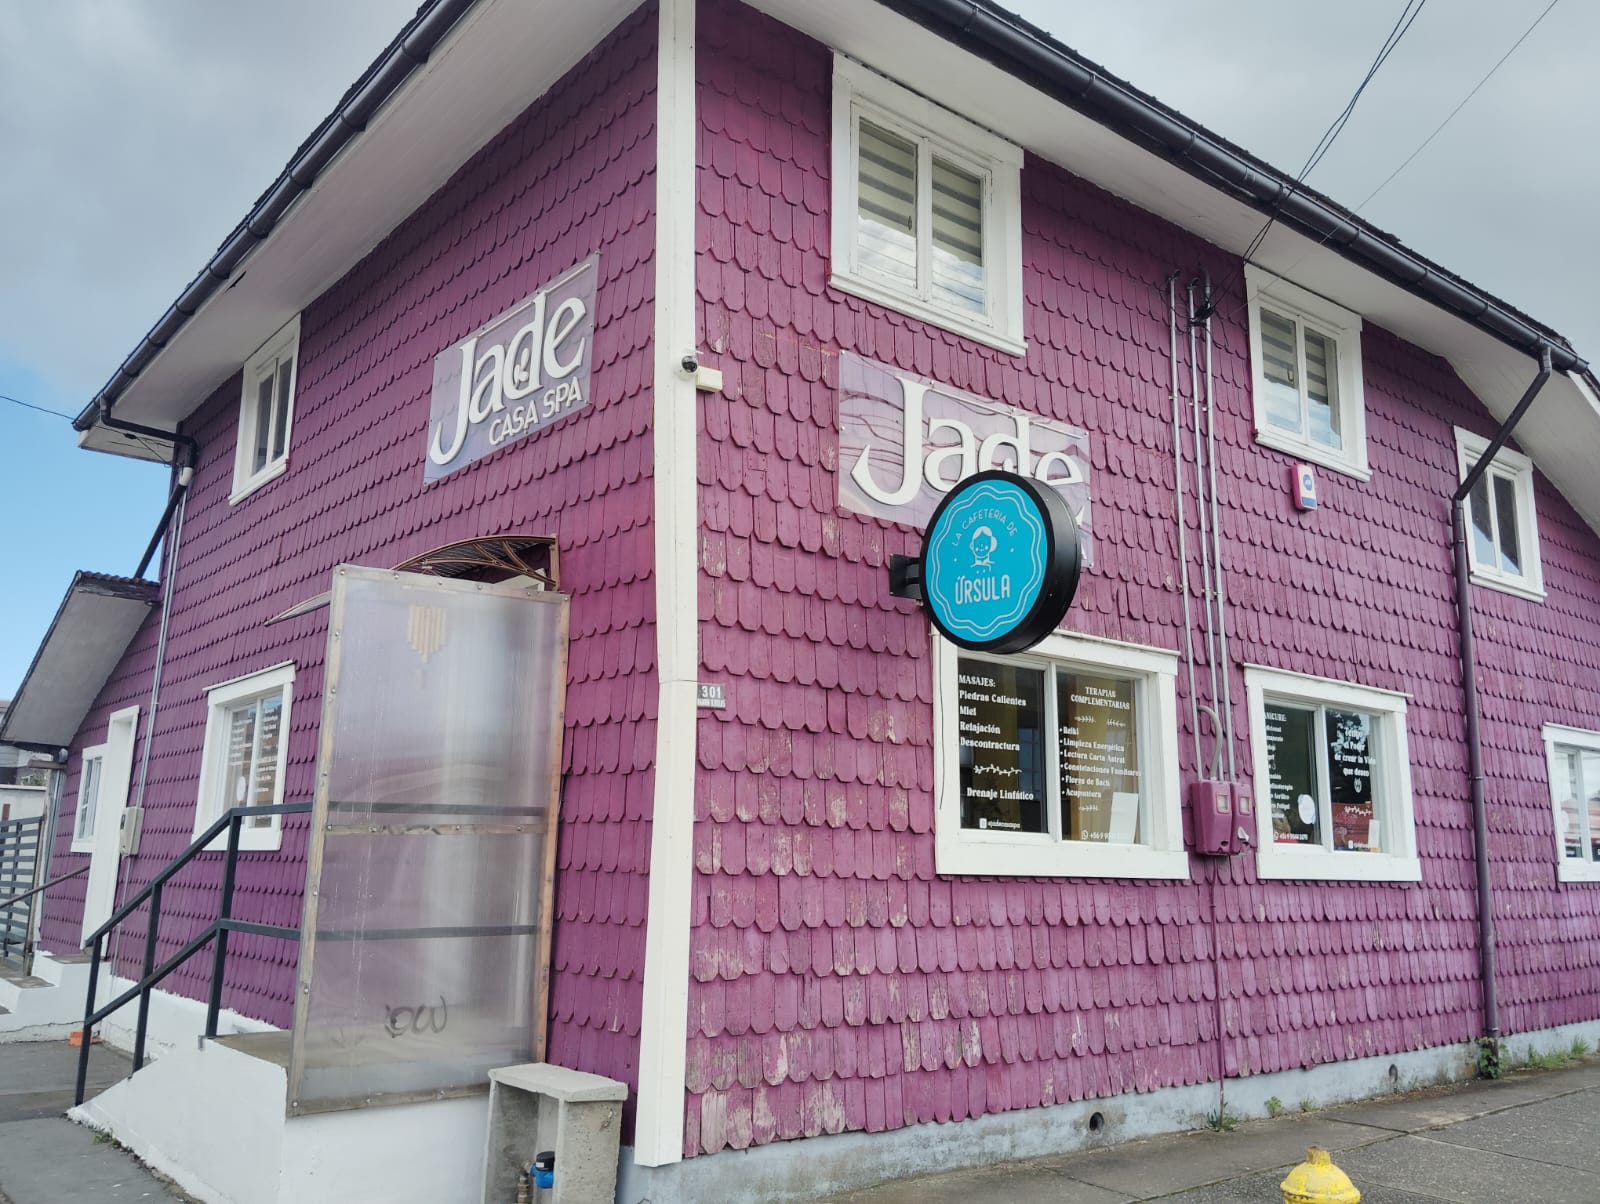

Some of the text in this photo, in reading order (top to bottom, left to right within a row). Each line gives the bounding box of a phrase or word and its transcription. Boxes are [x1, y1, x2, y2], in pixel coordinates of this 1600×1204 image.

[430, 290, 586, 465] Jade
[488, 375, 583, 446] CASA SPA
[951, 532, 963, 547] LA
[1006, 521, 1018, 537] DE
[958, 675, 996, 687] MASAJES:
[701, 685, 721, 699] 301
[959, 689, 1027, 707] Piedras Calientes
[1085, 686, 1117, 698] TERAPIAS
[1070, 694, 1130, 710] COMPLEMENTARIAS
[959, 705, 977, 717] Miel
[959, 721, 1001, 735] Relajación
[960, 737, 1020, 751] Descontractura
[966, 787, 1034, 800] Drenaje Linfático
